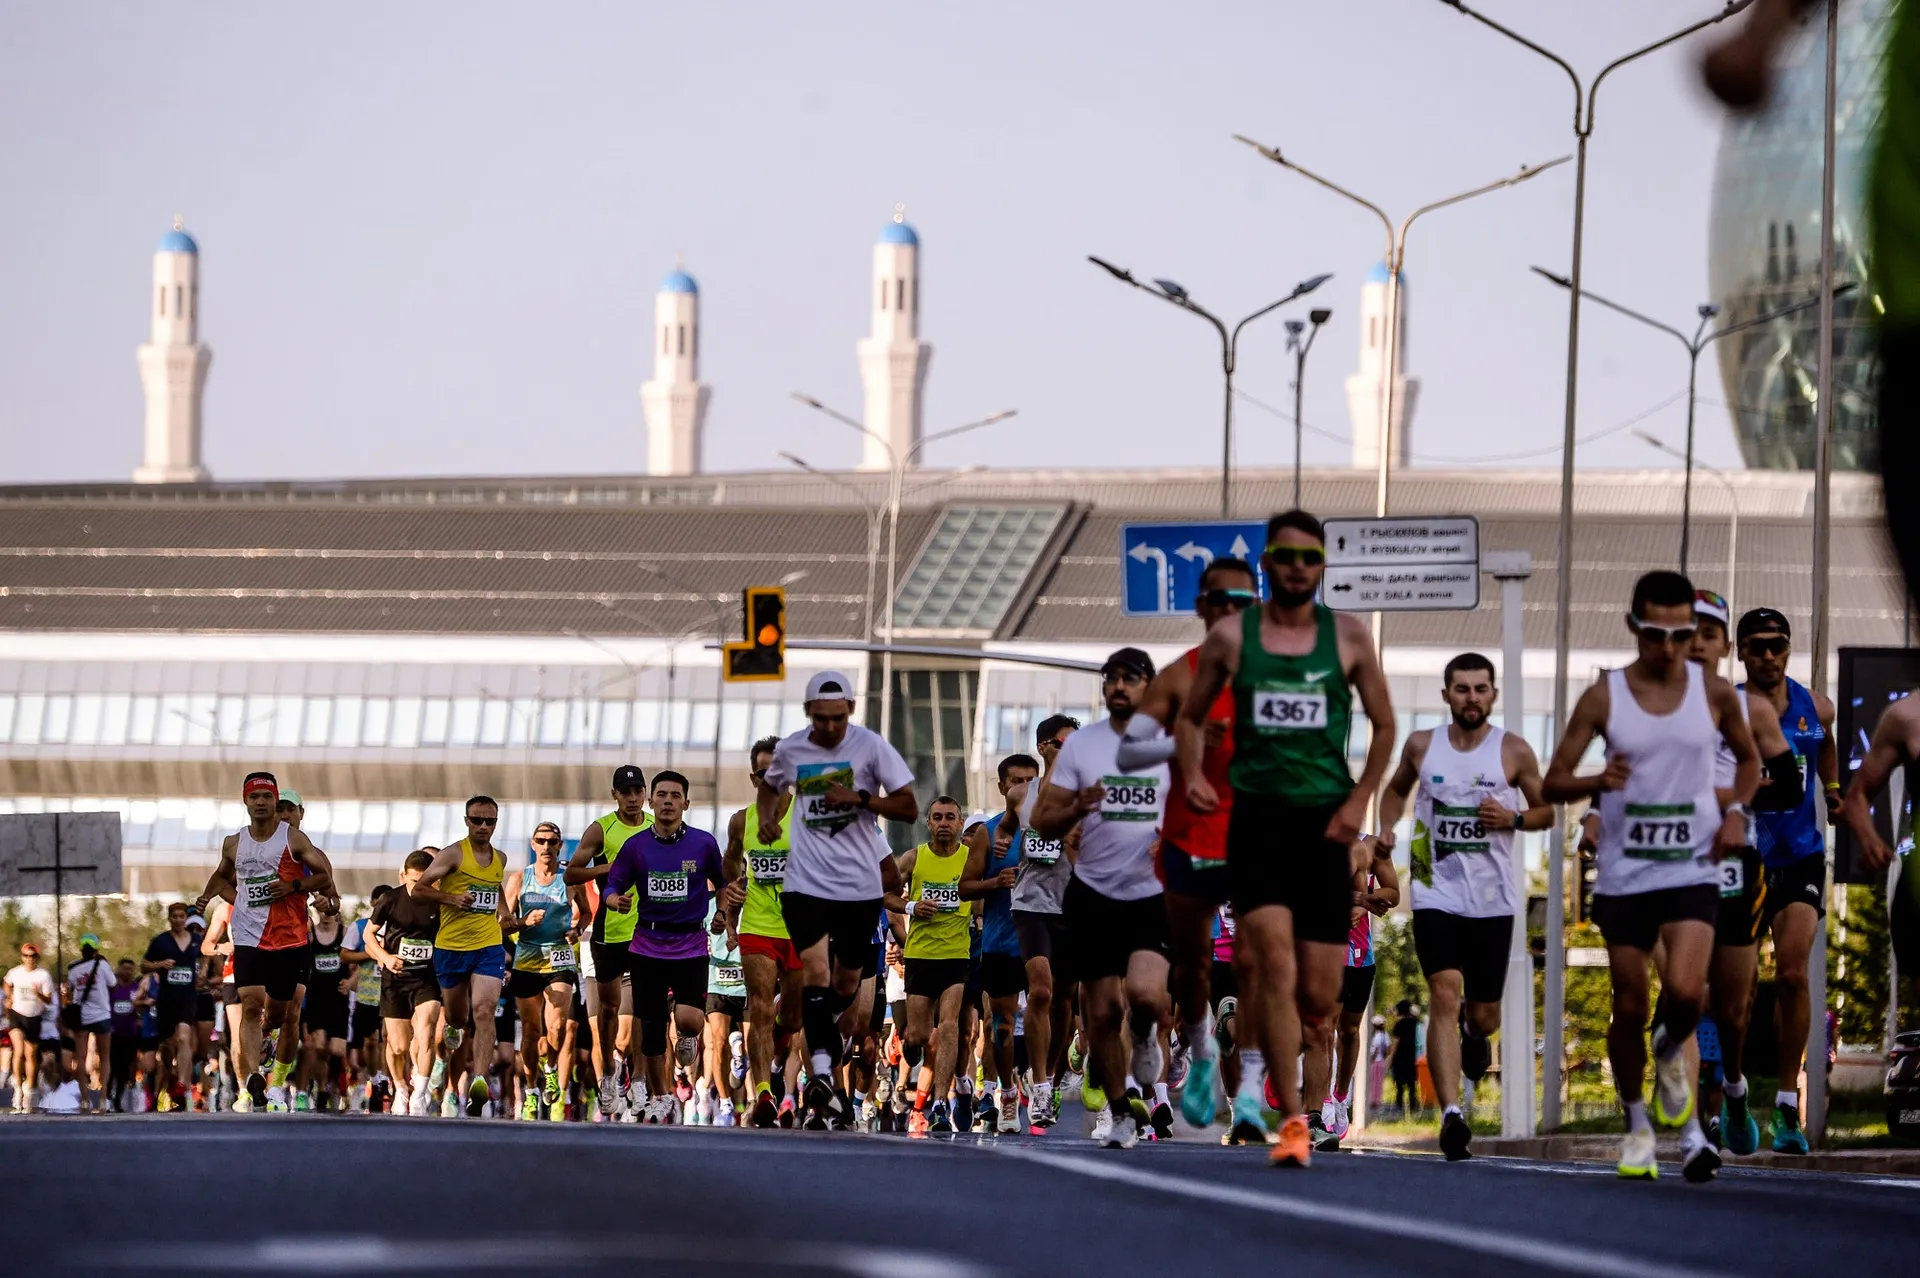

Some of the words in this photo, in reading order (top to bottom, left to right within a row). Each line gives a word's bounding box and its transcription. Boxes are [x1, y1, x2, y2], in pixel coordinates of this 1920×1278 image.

[1260, 699, 1321, 722] 4367
[1106, 787, 1156, 805] 3058
[1437, 820, 1487, 839] 4768
[1629, 821, 1691, 845] 4778
[752, 858, 787, 873] 3952
[248, 885, 271, 899] 536
[650, 879, 685, 892] 3088
[470, 891, 497, 904] 3181
[924, 889, 958, 902] 3298
[401, 947, 429, 959] 5421
[719, 970, 744, 979] 5291
